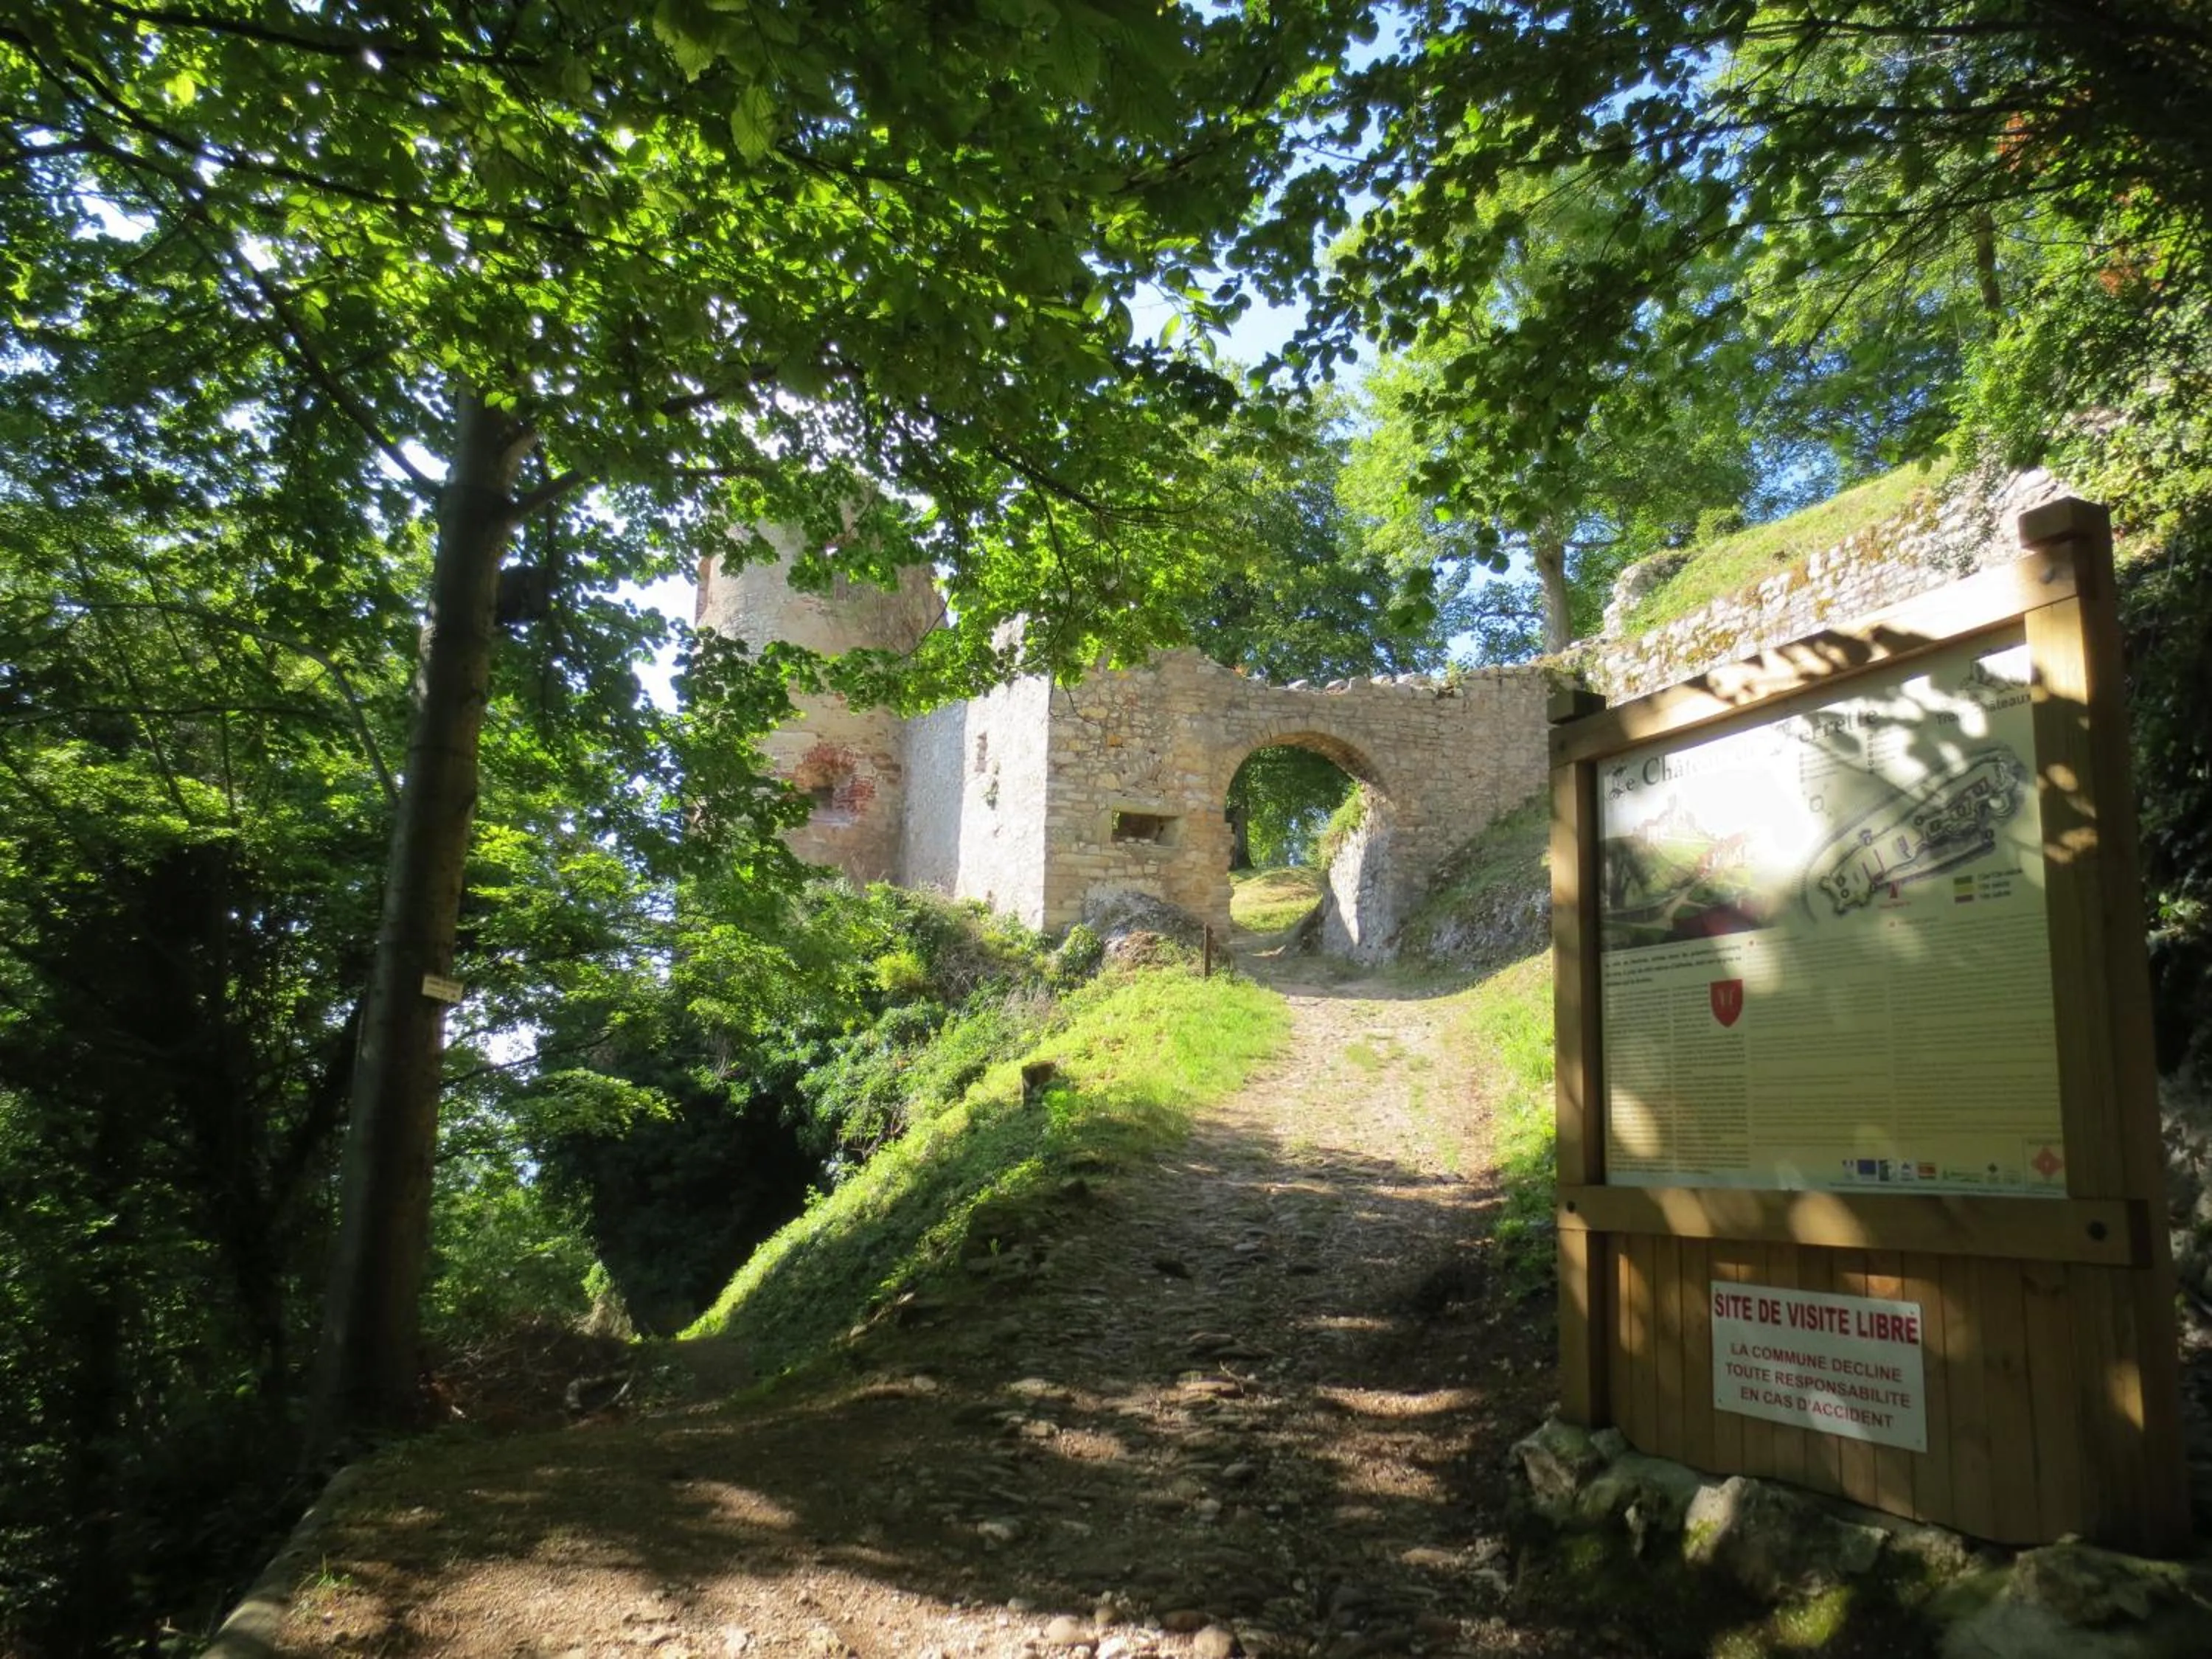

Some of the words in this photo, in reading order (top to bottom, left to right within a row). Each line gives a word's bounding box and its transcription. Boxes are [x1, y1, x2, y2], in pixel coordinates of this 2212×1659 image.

[1714, 1293, 1753, 1321] SITE
[1759, 1298, 1781, 1325] DE
[1786, 1301, 1851, 1335] VISITE
[1857, 1310, 1919, 1345] LIBRE
[1731, 1343, 1749, 1357] LA
[1752, 1346, 1826, 1370] COMMUNE
[1832, 1358, 1902, 1382] DECLINE
[1725, 1363, 1770, 1382] TOUTE
[1775, 1371, 1912, 1408] RESPONSABILITE
[1740, 1386, 1759, 1402] EN
[1763, 1391, 1793, 1409] CAS
[1797, 1398, 1893, 1427] D'ACCIDENT
